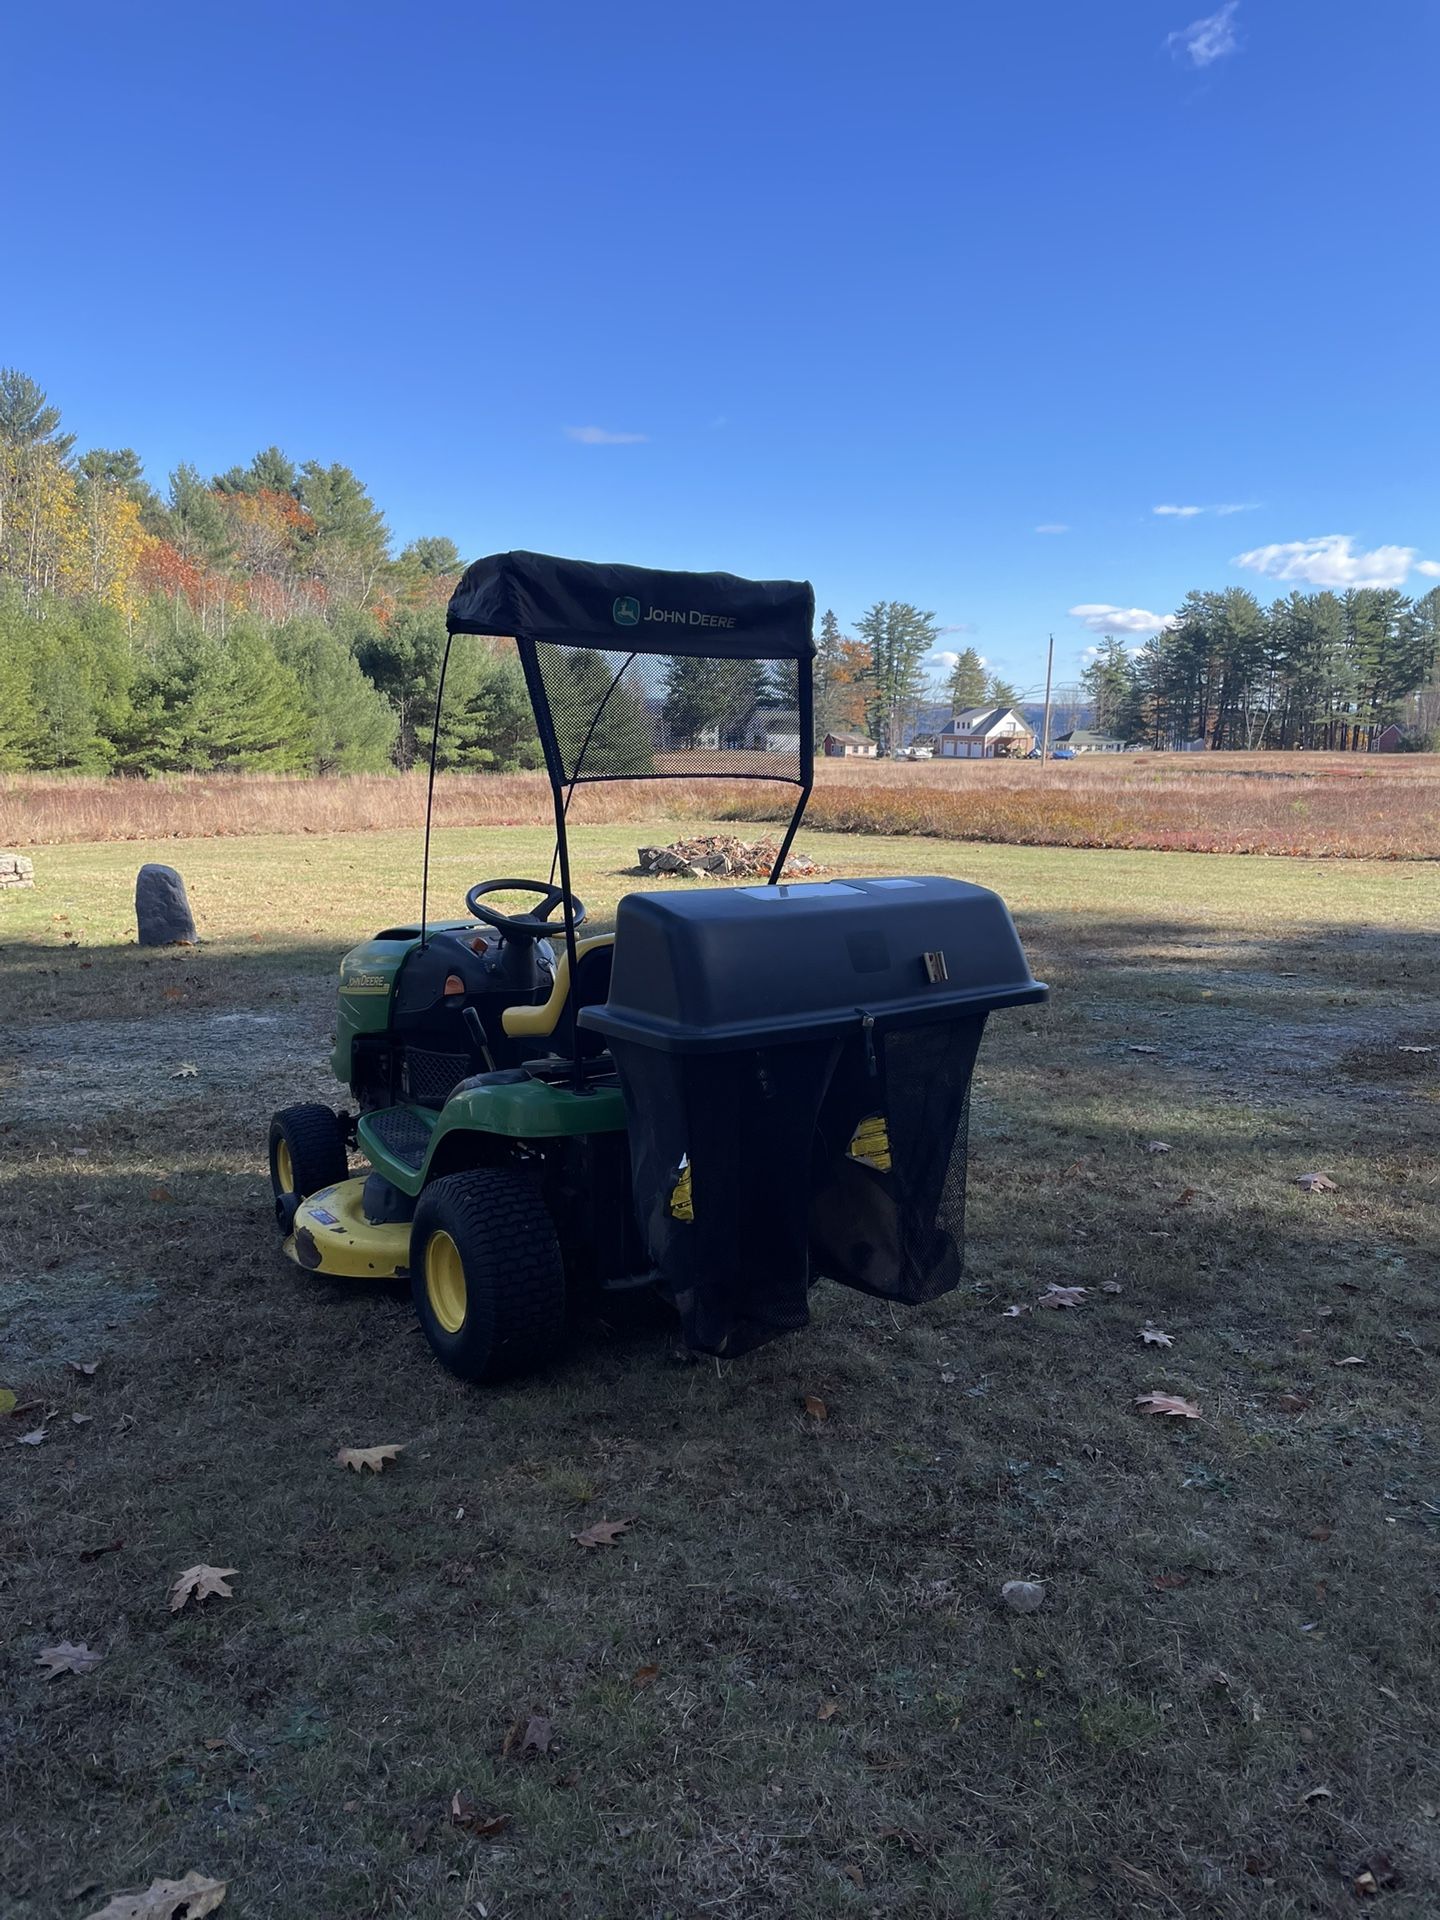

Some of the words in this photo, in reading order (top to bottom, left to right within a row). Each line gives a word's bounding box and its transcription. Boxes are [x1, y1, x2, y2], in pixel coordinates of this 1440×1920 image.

[643, 606, 686, 624] JOHN
[689, 610, 737, 629] DEERE
[360, 974, 385, 986] DEERE
